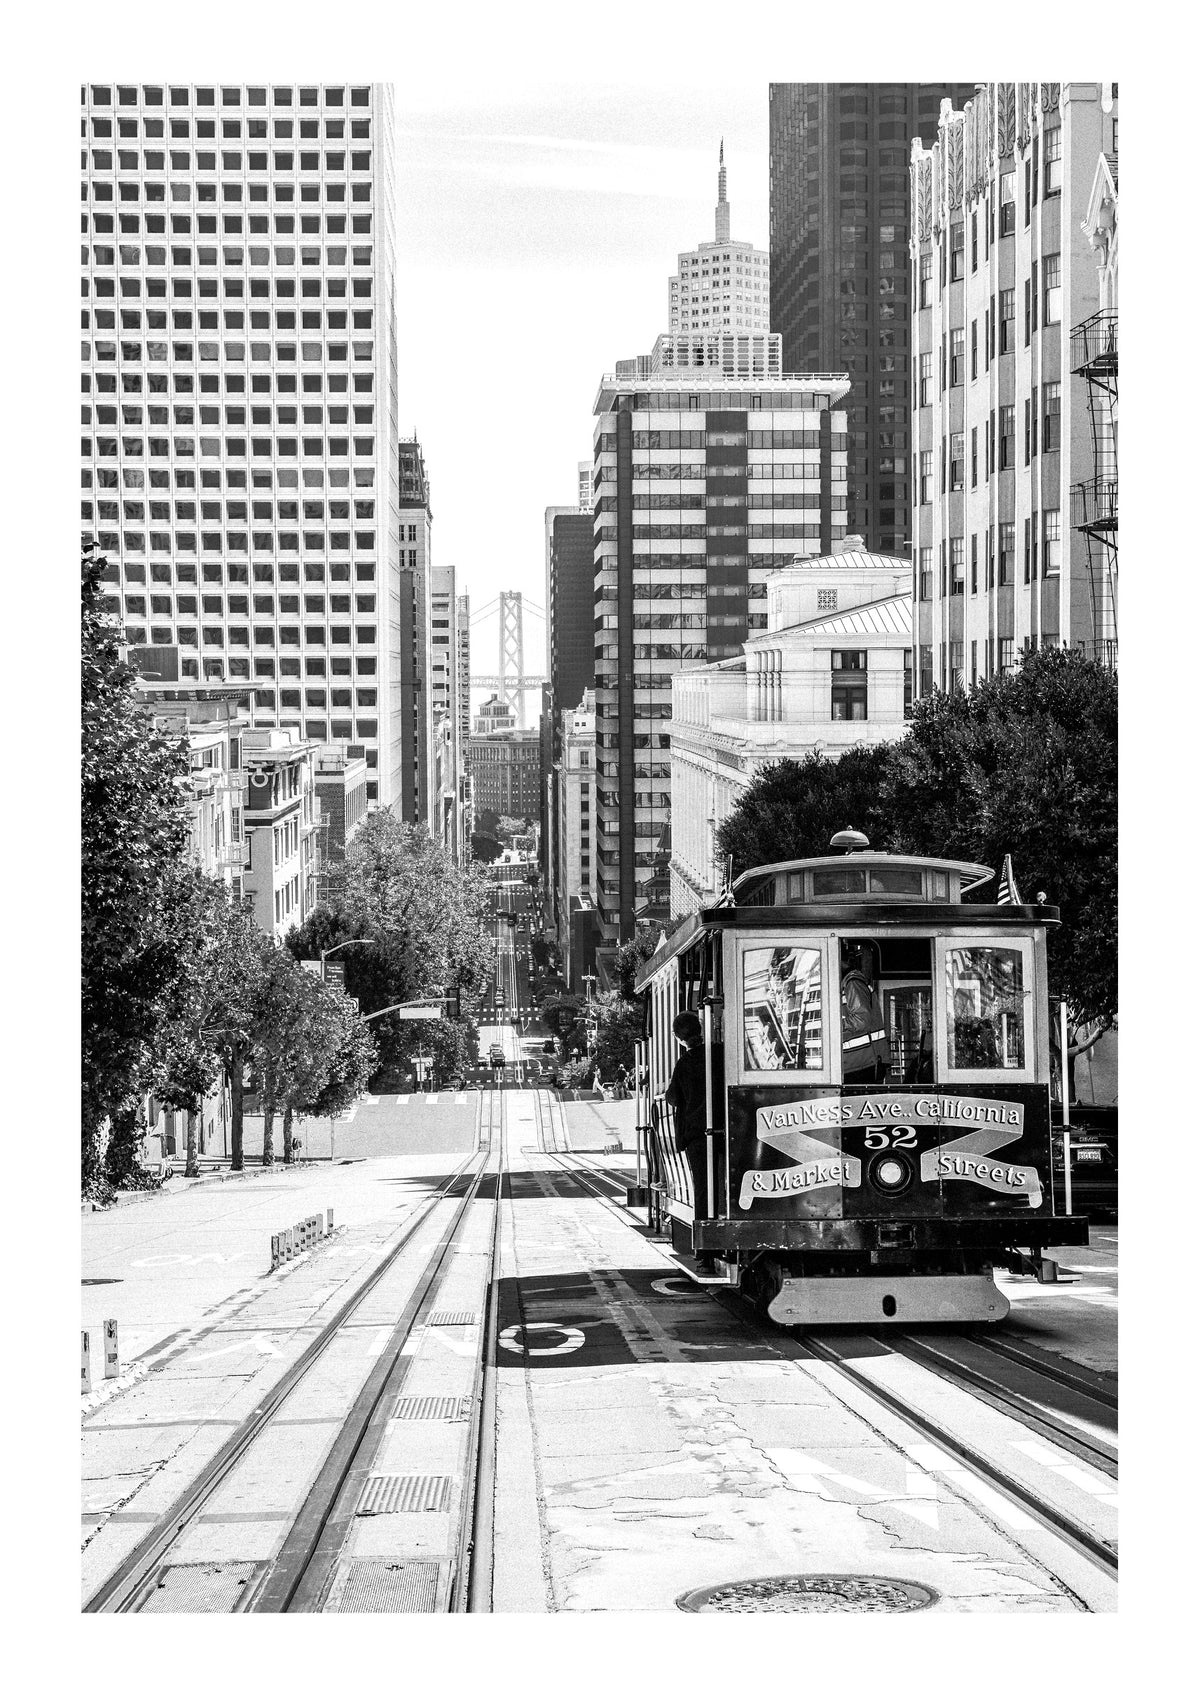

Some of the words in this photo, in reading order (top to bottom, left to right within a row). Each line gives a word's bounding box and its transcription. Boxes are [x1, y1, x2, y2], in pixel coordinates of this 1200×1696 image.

[915, 1099, 1020, 1125] California
[864, 1126, 918, 1150] 52
[752, 1172, 768, 1192] &
[771, 1162, 850, 1193] Market
[938, 1155, 1027, 1187] Streets
